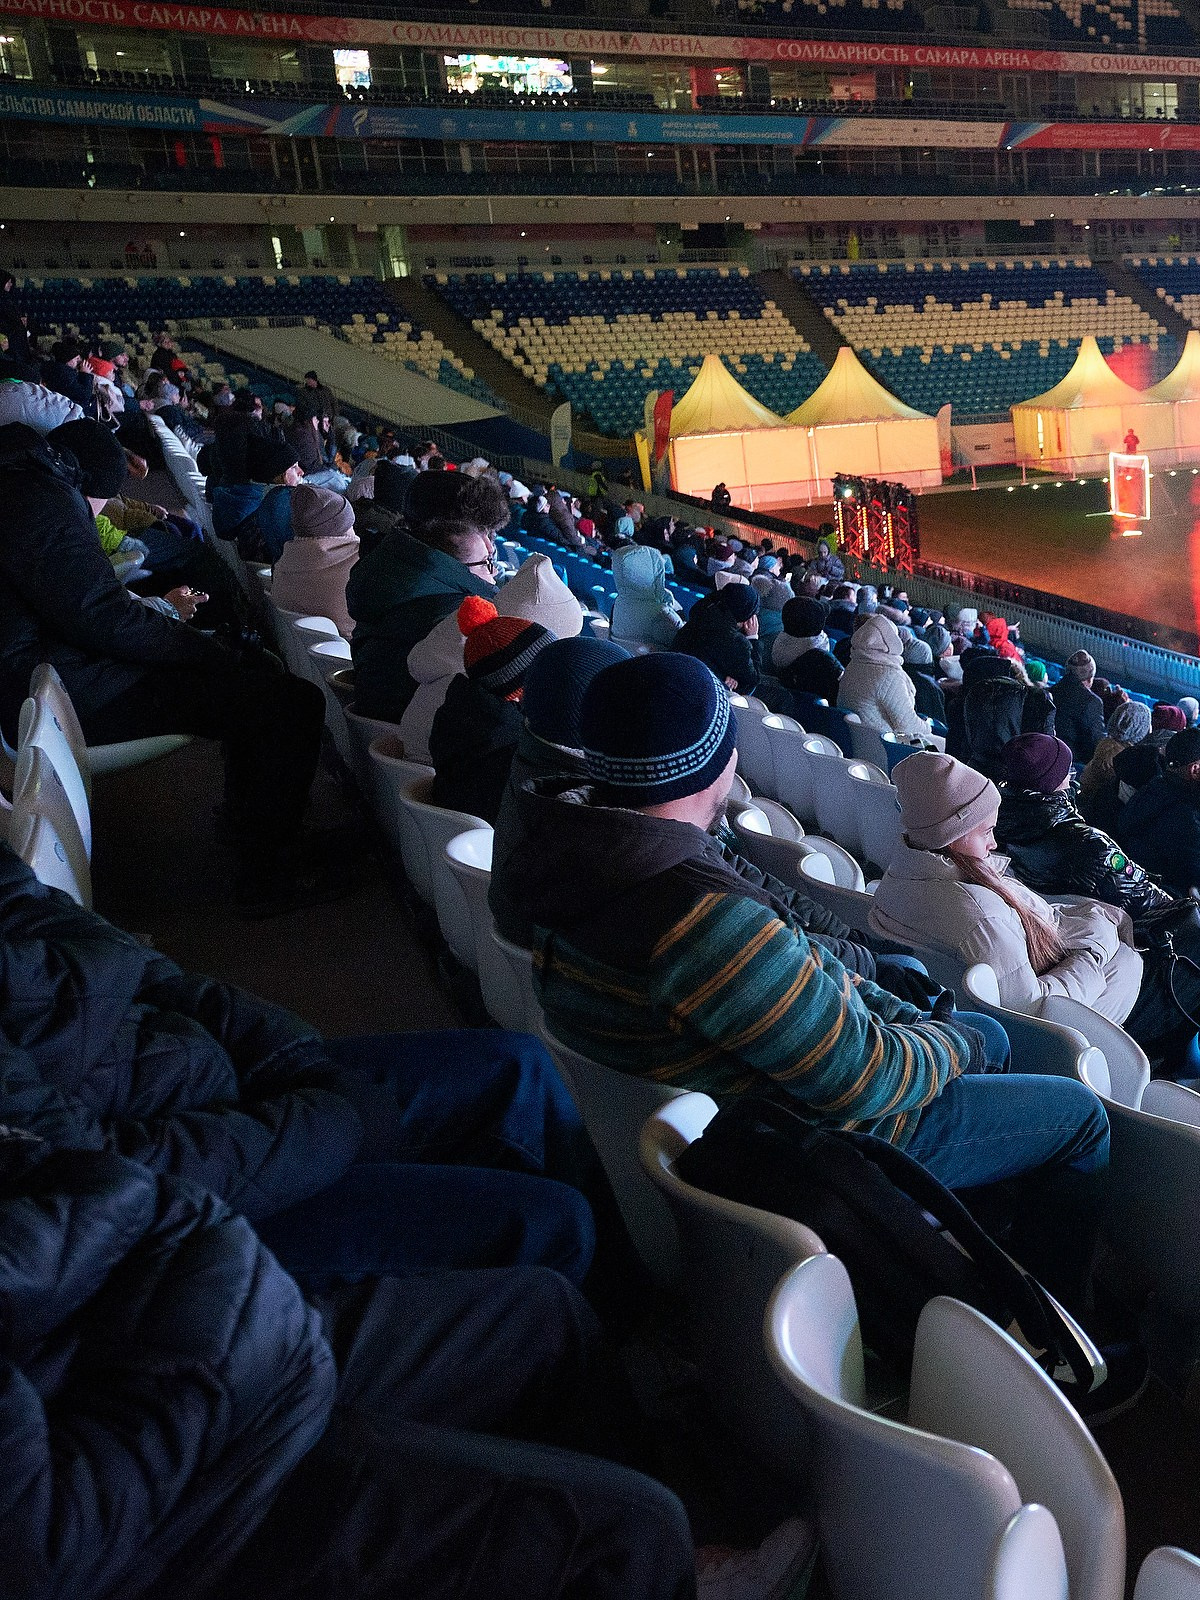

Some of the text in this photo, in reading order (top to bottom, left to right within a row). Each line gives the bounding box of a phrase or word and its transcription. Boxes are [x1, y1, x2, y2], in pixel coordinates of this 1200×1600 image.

[133, 5, 228, 29] САМАРА
[235, 12, 302, 35] АРЕНА
[392, 25, 702, 53] СОЛИДАРНОСТЬ САМАРА АРЕНА
[776, 42, 1031, 66] СОЛИДАРНОСТЬ САМАРА АРЕНА
[1090, 56, 1200, 73] СОЛИДАРНОСТЬ
[57, 98, 135, 121] САМАРСКОЙ
[137, 104, 196, 125] ОБЛАСТИ
